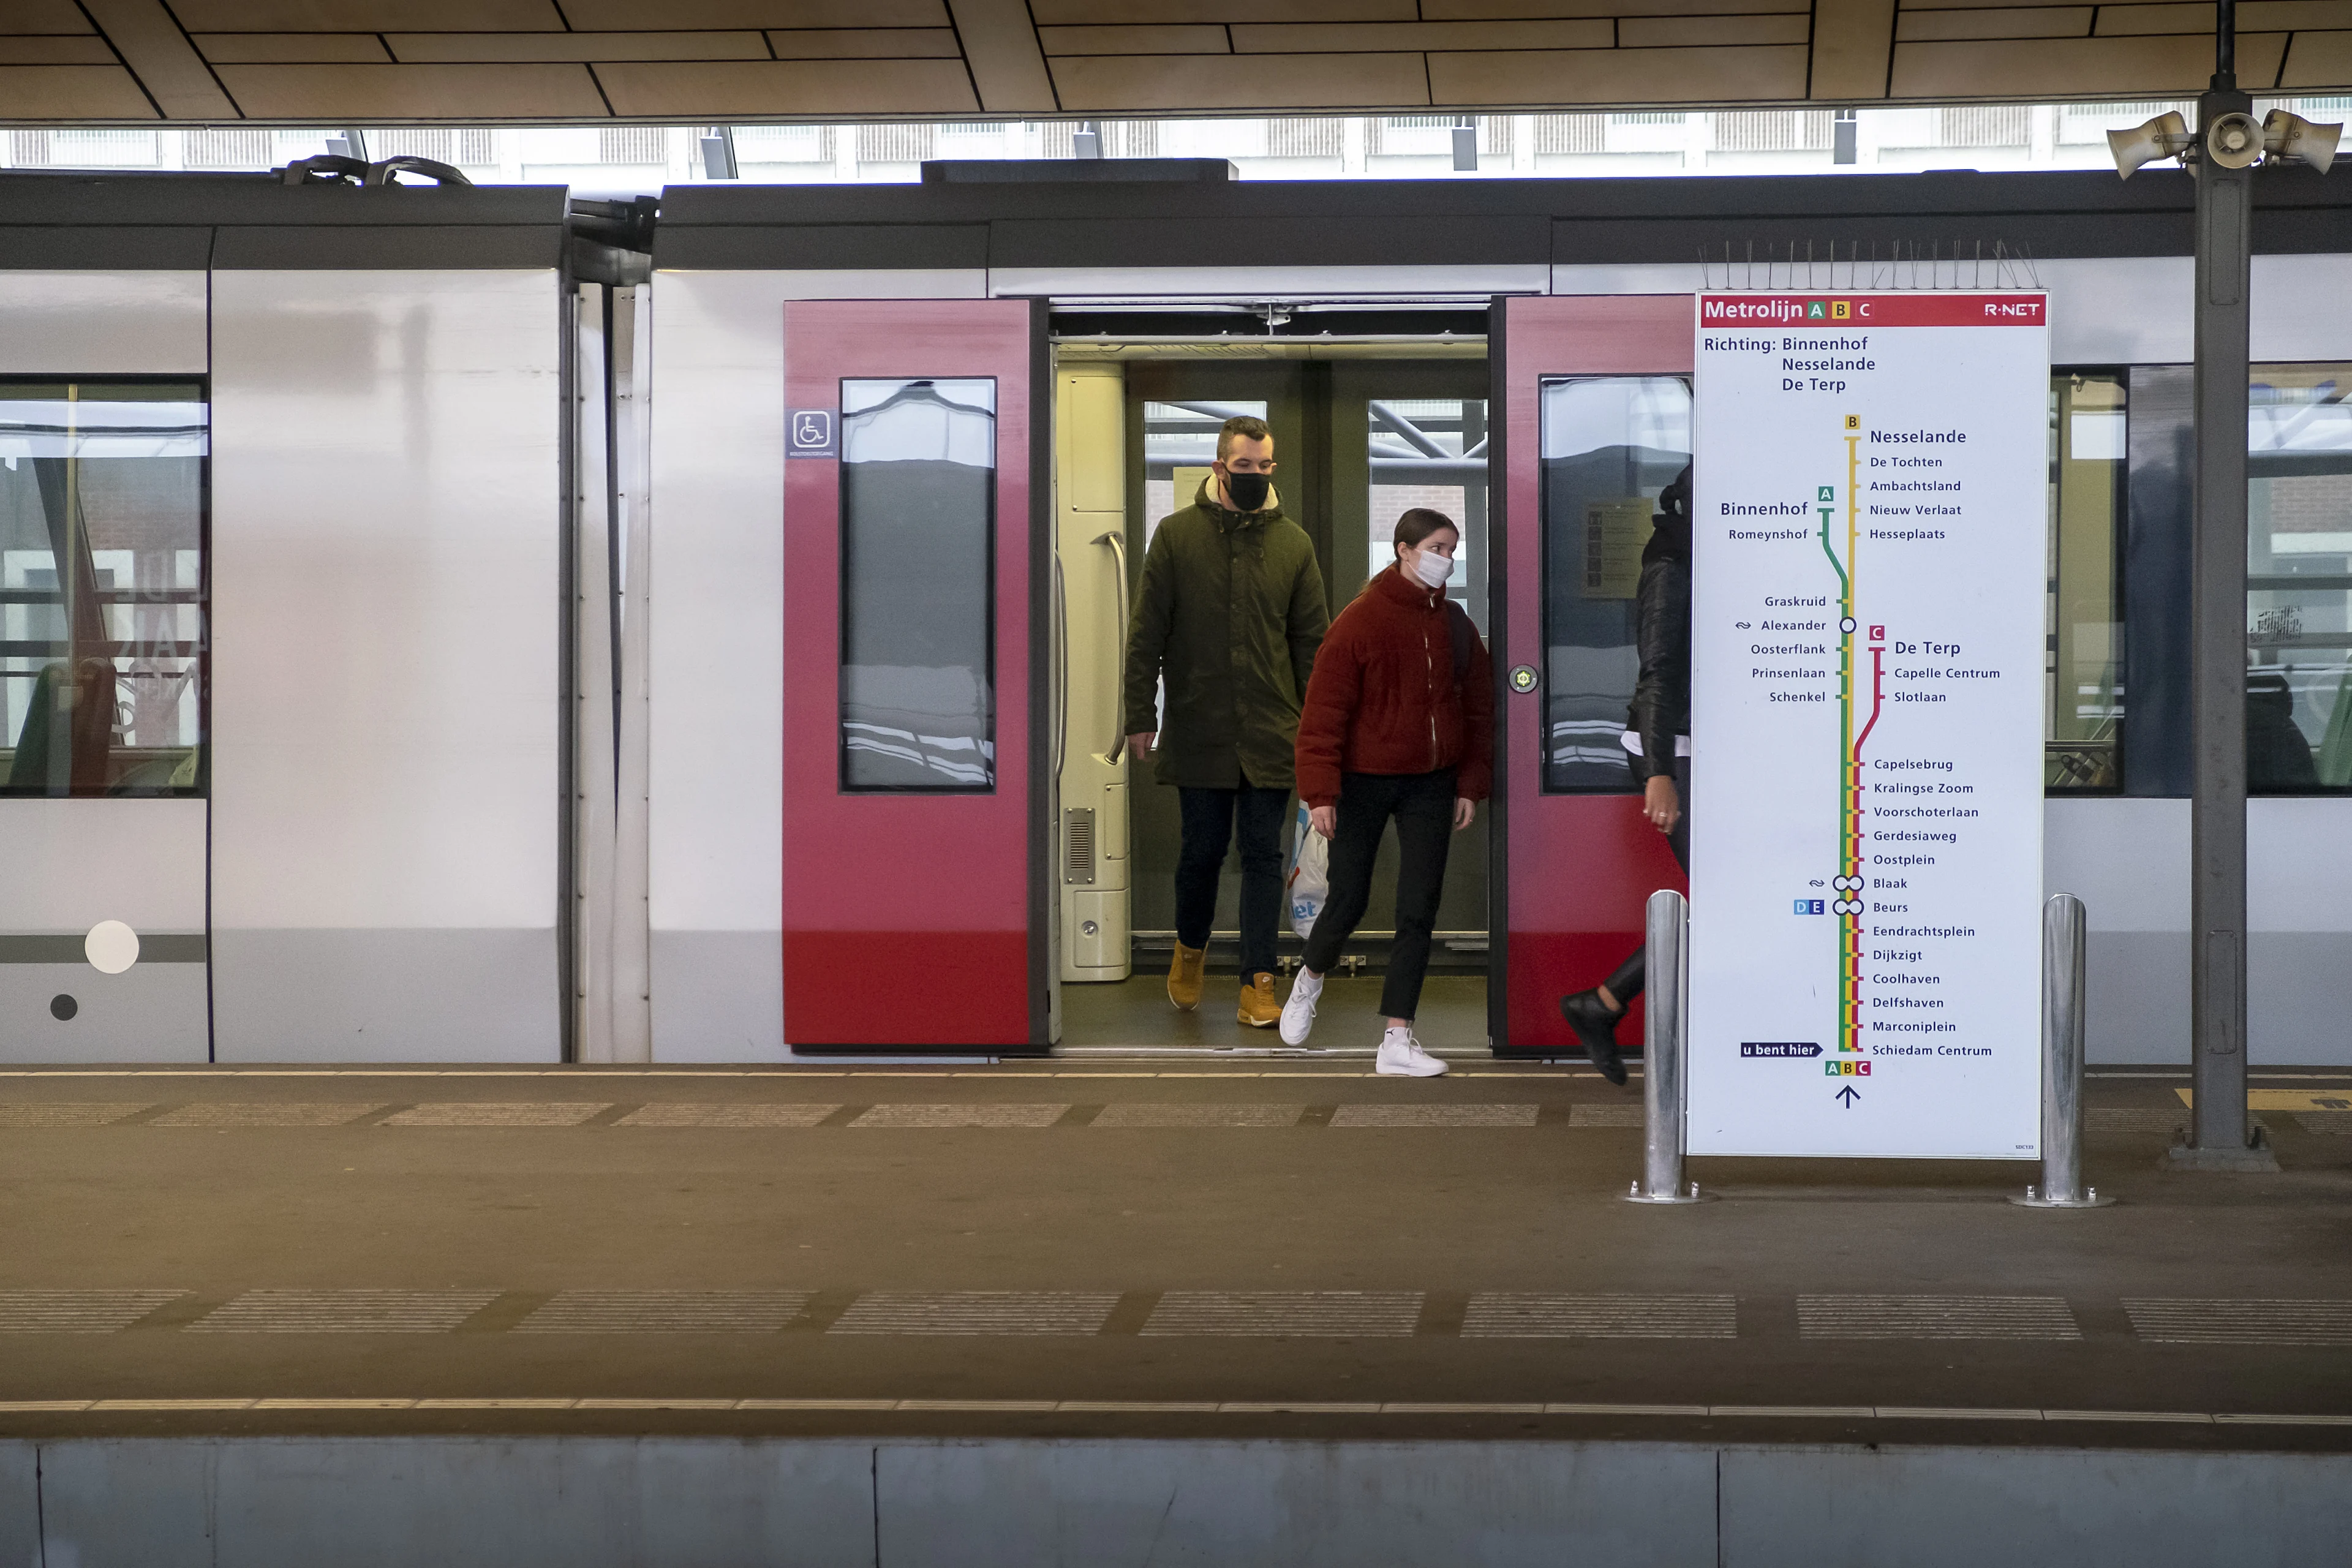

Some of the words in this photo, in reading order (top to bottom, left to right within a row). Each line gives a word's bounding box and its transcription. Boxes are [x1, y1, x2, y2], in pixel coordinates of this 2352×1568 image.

[1706, 300, 1803, 322] Metrolijn
[1811, 304, 1823, 317] A
[1836, 304, 1845, 316] B
[1860, 303, 1870, 317] C
[1705, 337, 1776, 354] Richting:
[1783, 336, 1868, 350] Binnenhof
[1782, 356, 1875, 371] Nesselande
[1782, 378, 1803, 391] De
[1809, 378, 1845, 394] Terp
[1849, 417, 1857, 428] B
[1871, 429, 1966, 443] Nesselande
[1871, 457, 1887, 467] De
[1891, 456, 1942, 467] Tochten
[1870, 480, 1961, 491] Ambachtsland
[1820, 488, 1831, 500] A
[1721, 502, 1808, 515] Binnenhof
[1870, 505, 1910, 515] Nieuw
[1915, 504, 1961, 515] Verlaat
[1729, 529, 1808, 542] Romeynshof
[1870, 529, 1945, 541] Hesseplaats
[1765, 595, 1826, 606] Graskruid
[1761, 620, 1826, 630] Alexander
[1872, 627, 1882, 639] C
[1751, 644, 1826, 654] Oosterflank
[1895, 641, 1917, 654] De
[1923, 641, 1961, 658] Terp
[1752, 668, 1825, 678] Prinsenlaan
[1894, 668, 1941, 680] Capelle
[1946, 668, 2000, 678] Centrum
[1770, 692, 1825, 702] Schenkel
[1894, 692, 1946, 702] Slotlaan
[1874, 759, 1953, 772] Capelsebrug
[1874, 783, 1934, 796] Kralingse
[1938, 783, 1973, 793] Zoom
[1874, 806, 1978, 817] Voorschoterlaan
[1874, 830, 1956, 843] Gerdesiaweg
[1874, 854, 1935, 867] Oostplein
[1874, 878, 1907, 889] Blaak
[1796, 902, 1806, 913] D
[1813, 902, 1820, 913] E
[1874, 902, 1908, 913] Beurs
[1874, 925, 1975, 939] Eendrachtsplein
[1873, 949, 1923, 963] Dijkzigt
[1873, 973, 1940, 984] Coolhaven
[1873, 997, 1943, 1008] Delfshaven
[1873, 1021, 1956, 1034] Marconiplein
[1744, 1047, 1751, 1055] u
[1755, 1044, 1785, 1055] bent
[1789, 1044, 1814, 1055] hier
[1872, 1044, 1932, 1055] Schiedam
[1937, 1046, 1992, 1056] Centrum
[1828, 1063, 1838, 1074] A
[1844, 1063, 1852, 1074] B
[1859, 1063, 1868, 1074] C
